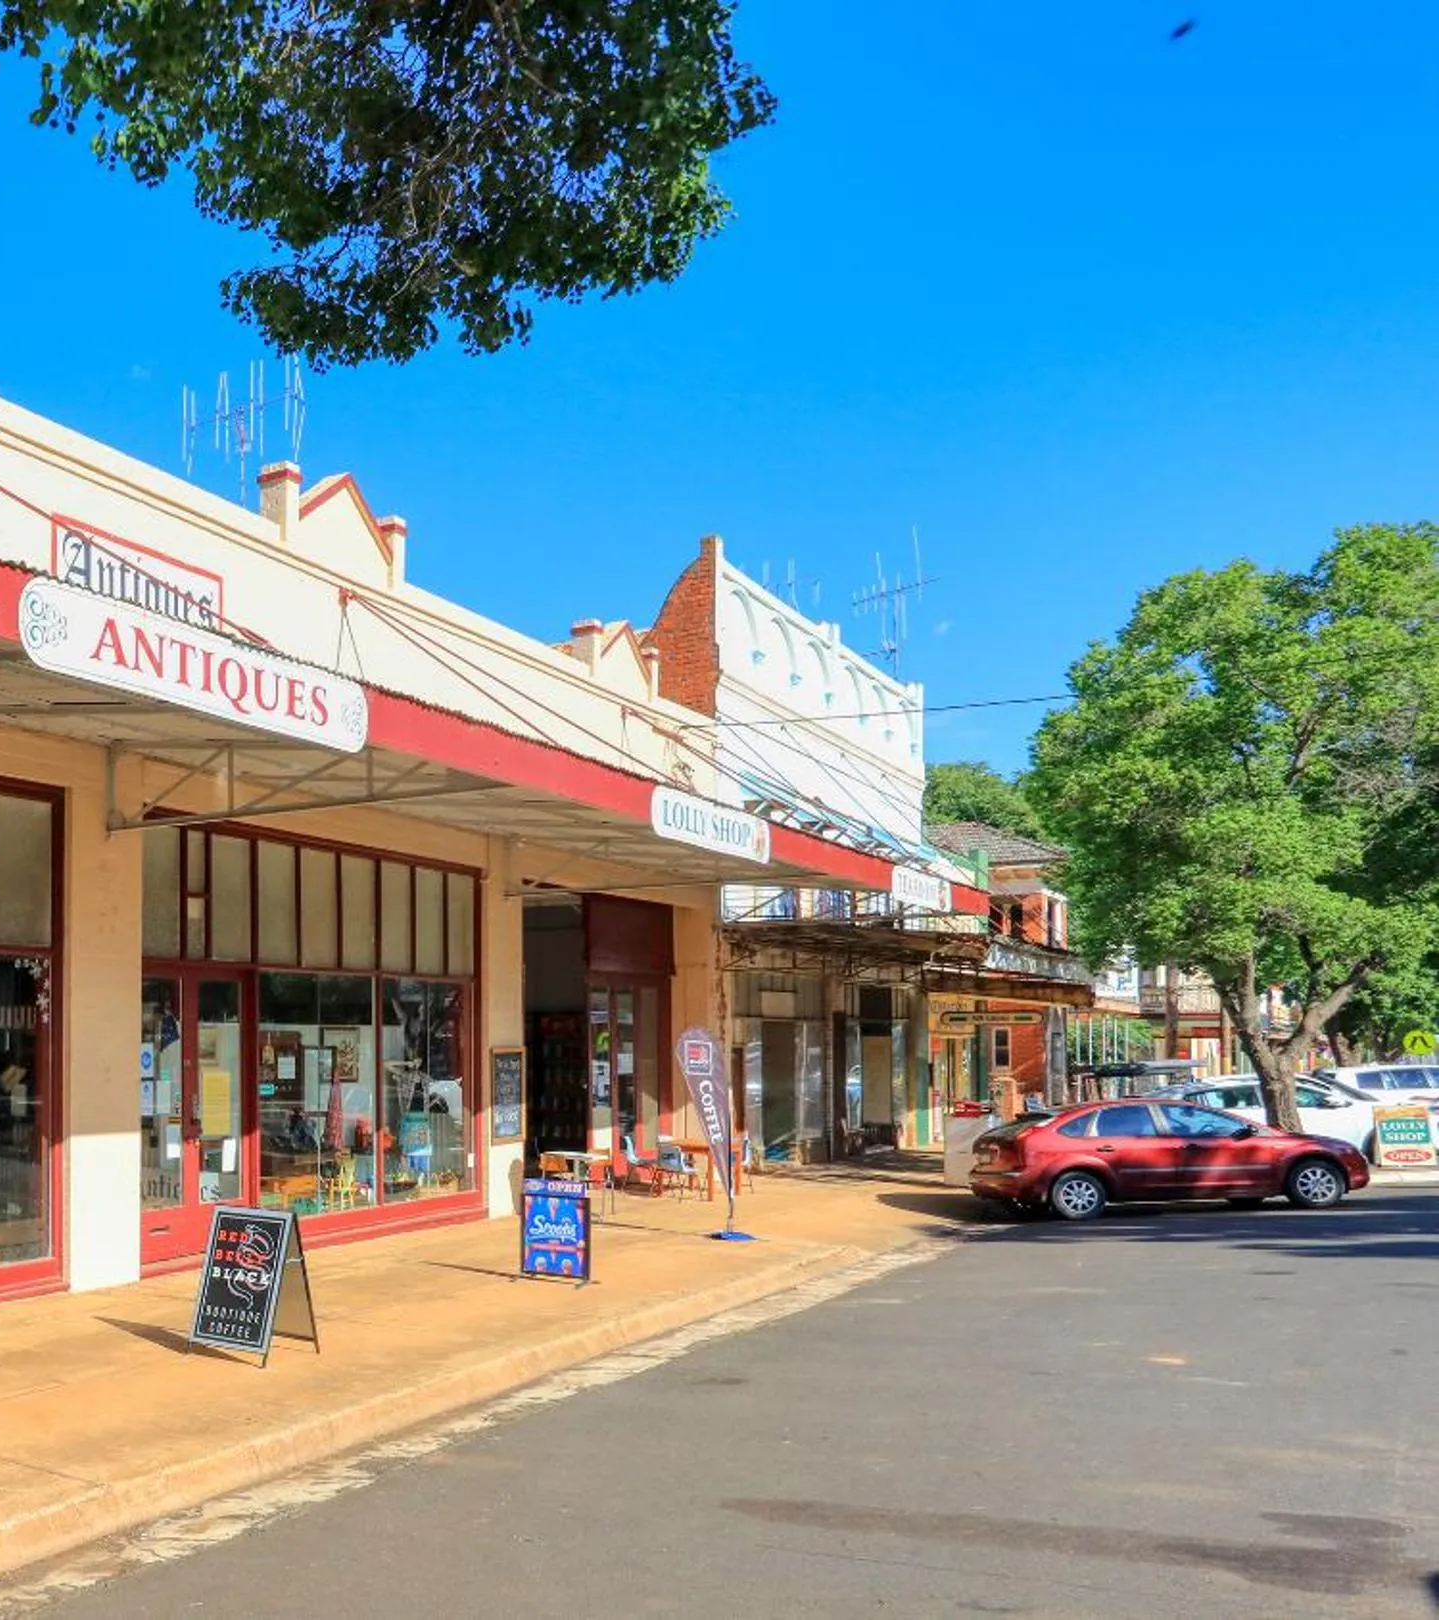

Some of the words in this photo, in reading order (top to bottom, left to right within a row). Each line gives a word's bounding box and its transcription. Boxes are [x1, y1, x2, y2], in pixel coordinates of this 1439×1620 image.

[89, 617, 329, 727] ANTIQUES
[663, 799, 705, 836] LOLLY
[711, 814, 750, 847] SHOP
[699, 1080, 724, 1146] COFFEE
[1385, 1132, 1426, 1141] SHOP
[218, 1230, 250, 1243] RED
[212, 1267, 271, 1284] BLACK
[210, 1322, 250, 1339] COFFEE
